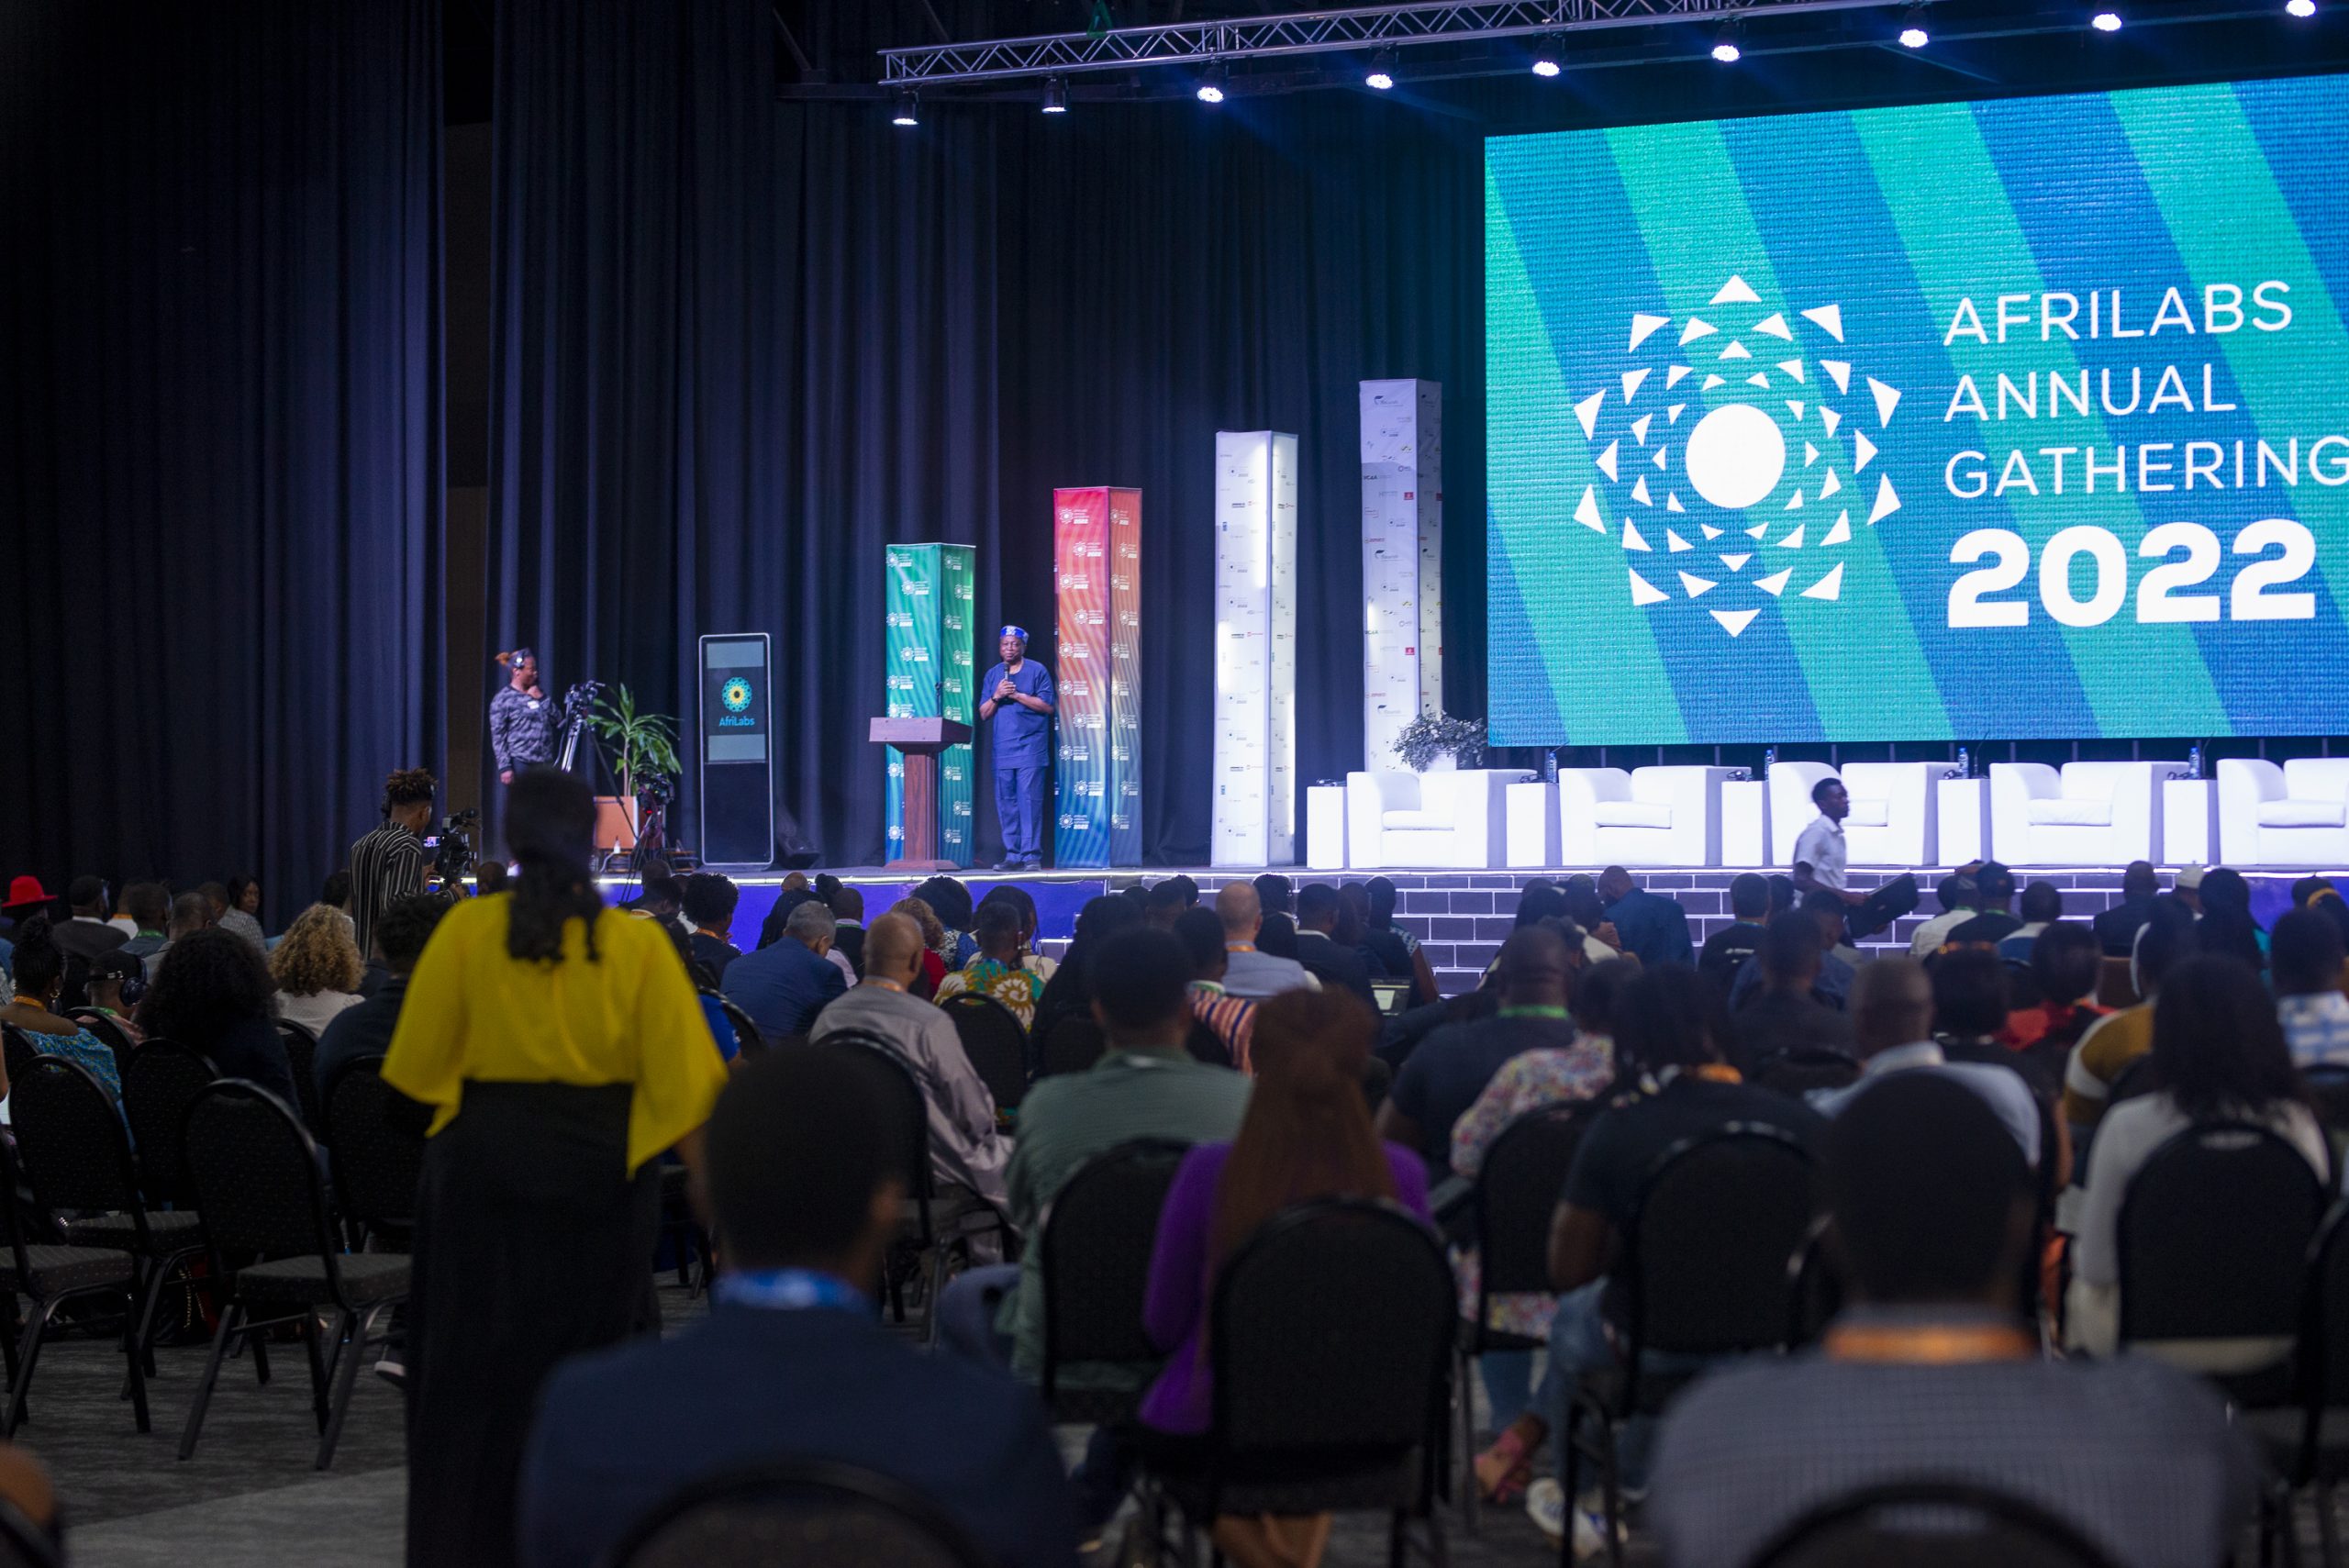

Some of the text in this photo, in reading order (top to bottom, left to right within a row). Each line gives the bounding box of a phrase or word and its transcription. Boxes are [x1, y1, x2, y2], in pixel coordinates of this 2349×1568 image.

[1944, 281, 2291, 345] AFRILABS
[1945, 364, 2235, 421] ANNUAL
[1945, 436, 2349, 497] GATHERING
[1948, 519, 2315, 628] 2022
[718, 716, 755, 726] AfriLabs
